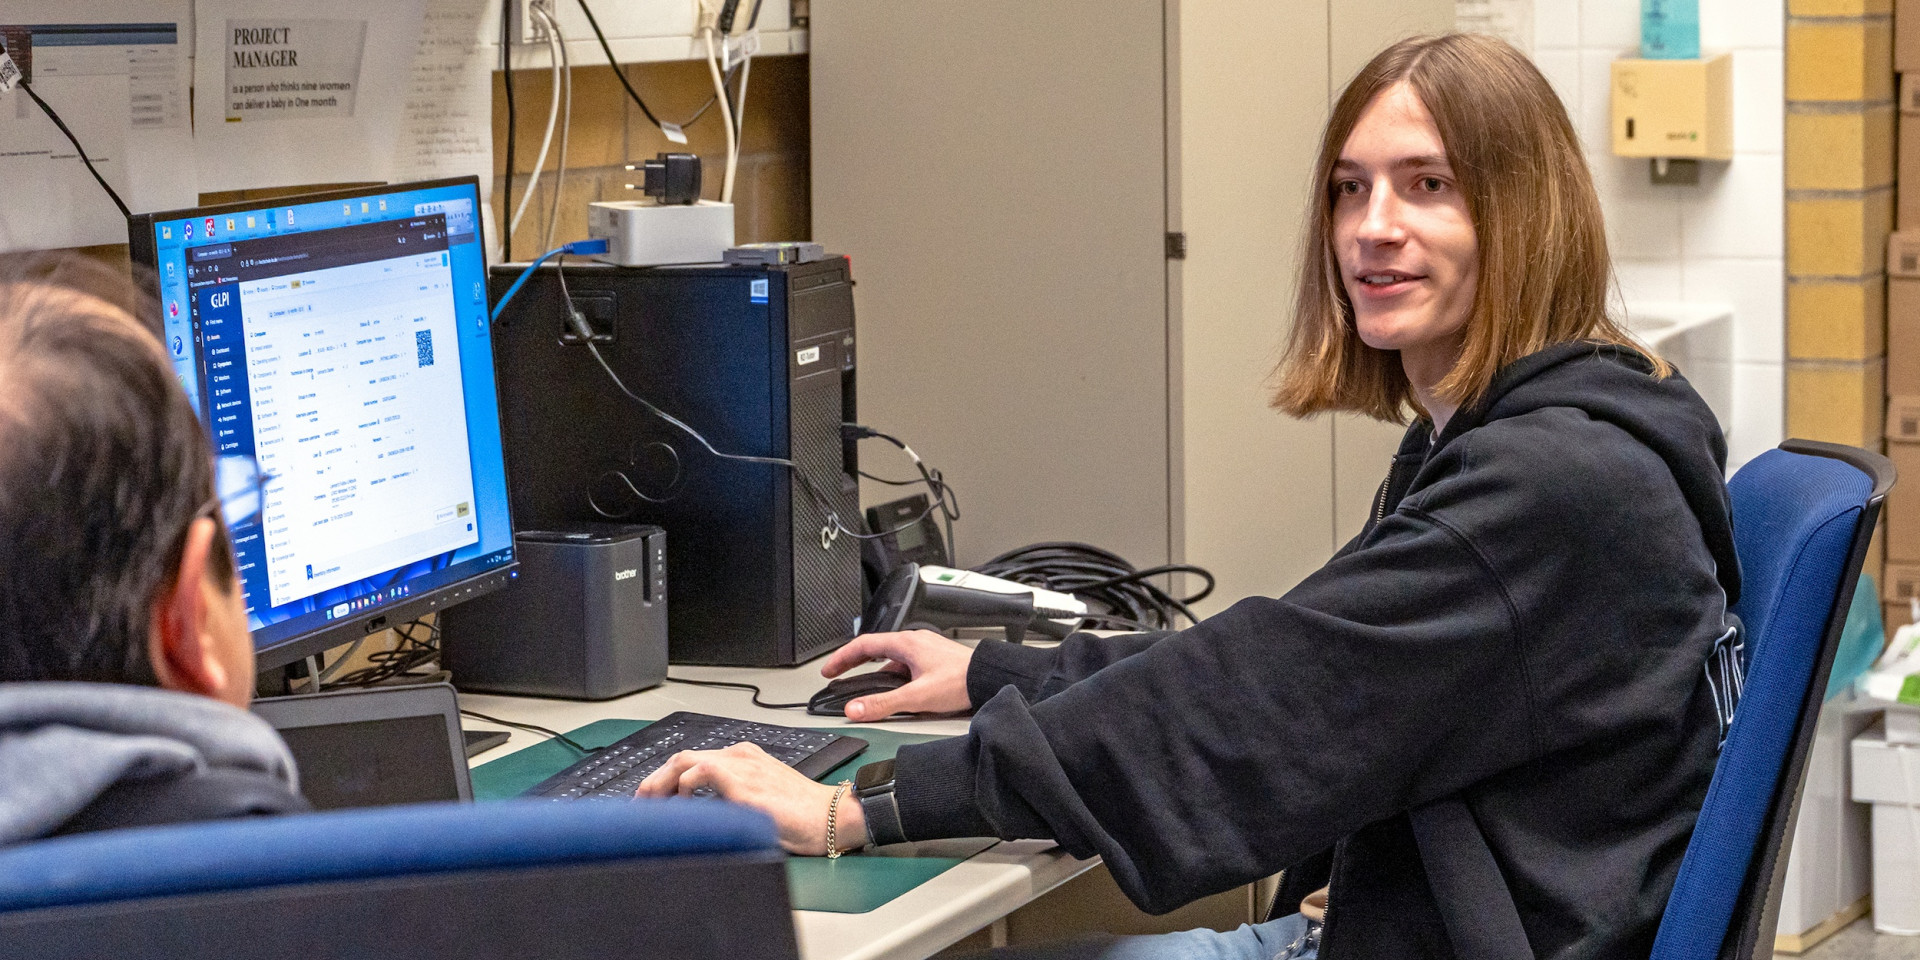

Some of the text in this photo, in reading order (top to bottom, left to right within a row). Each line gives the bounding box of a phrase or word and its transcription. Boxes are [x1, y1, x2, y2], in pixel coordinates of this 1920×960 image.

[234, 28, 290, 45] PROJECT
[233, 50, 298, 68] MANAGER
[245, 84, 264, 94] person
[266, 82, 279, 92] who
[280, 82, 299, 91] thinks
[301, 82, 317, 91] nine
[320, 82, 350, 91] women
[232, 102, 243, 110] can
[245, 100, 264, 109] deliver
[272, 98, 286, 110] baby
[295, 97, 309, 107] One
[311, 96, 337, 107] month
[210, 292, 230, 308] GLPI
[615, 569, 637, 580] brother
